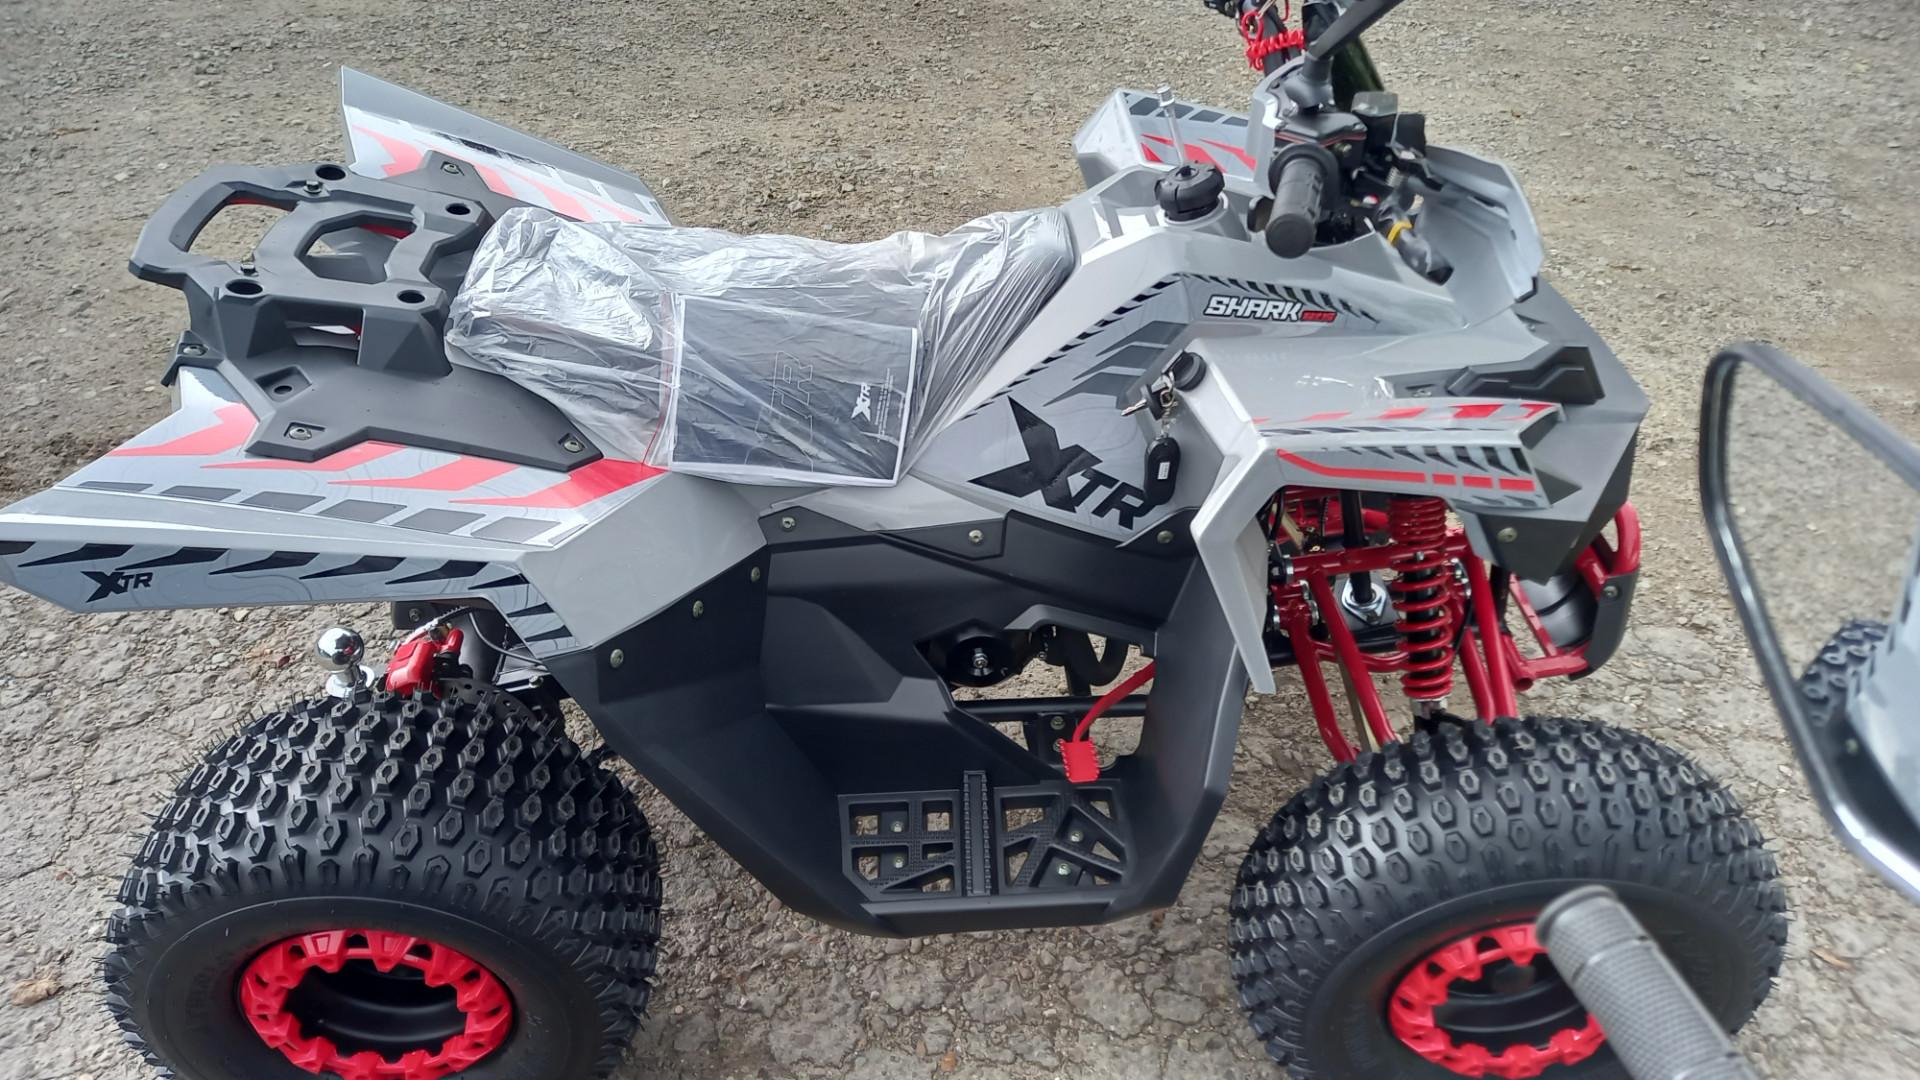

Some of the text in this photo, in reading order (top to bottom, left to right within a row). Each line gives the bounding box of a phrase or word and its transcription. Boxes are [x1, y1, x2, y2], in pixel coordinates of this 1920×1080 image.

[1204, 295, 1303, 321] SHARK
[851, 382, 871, 422] XTR
[967, 395, 1155, 530] XTR
[80, 571, 153, 603] XTR
